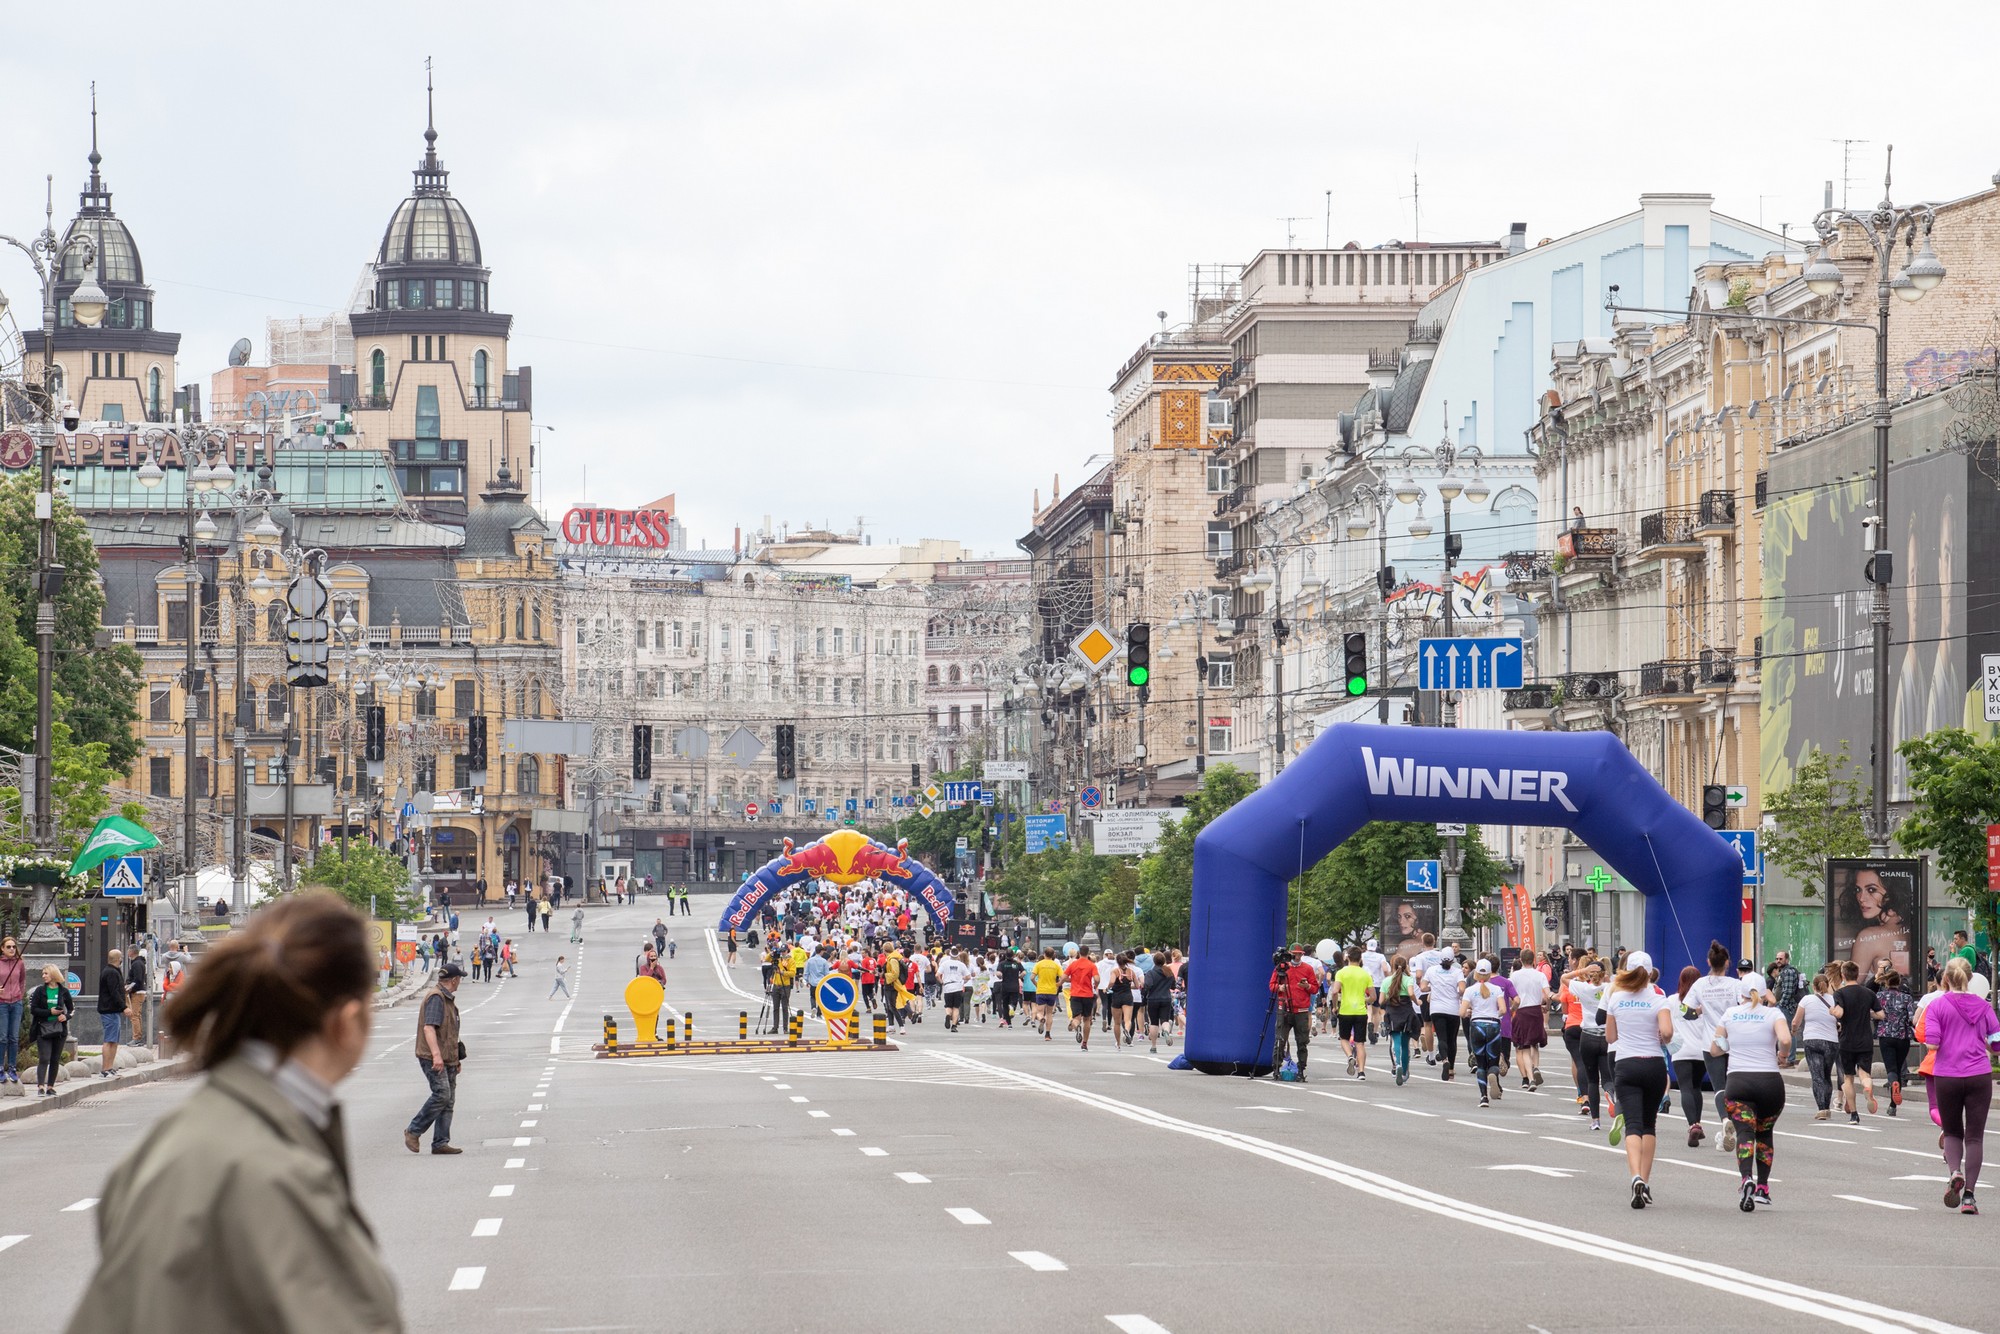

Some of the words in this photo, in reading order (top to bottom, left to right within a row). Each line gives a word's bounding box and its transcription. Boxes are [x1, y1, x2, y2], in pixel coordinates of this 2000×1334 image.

[562, 508, 670, 548] GUESS
[1361, 746, 1579, 812] WINNER
[729, 899, 752, 926] Red
[744, 880, 768, 905] Bull
[921, 885, 945, 910] Red
